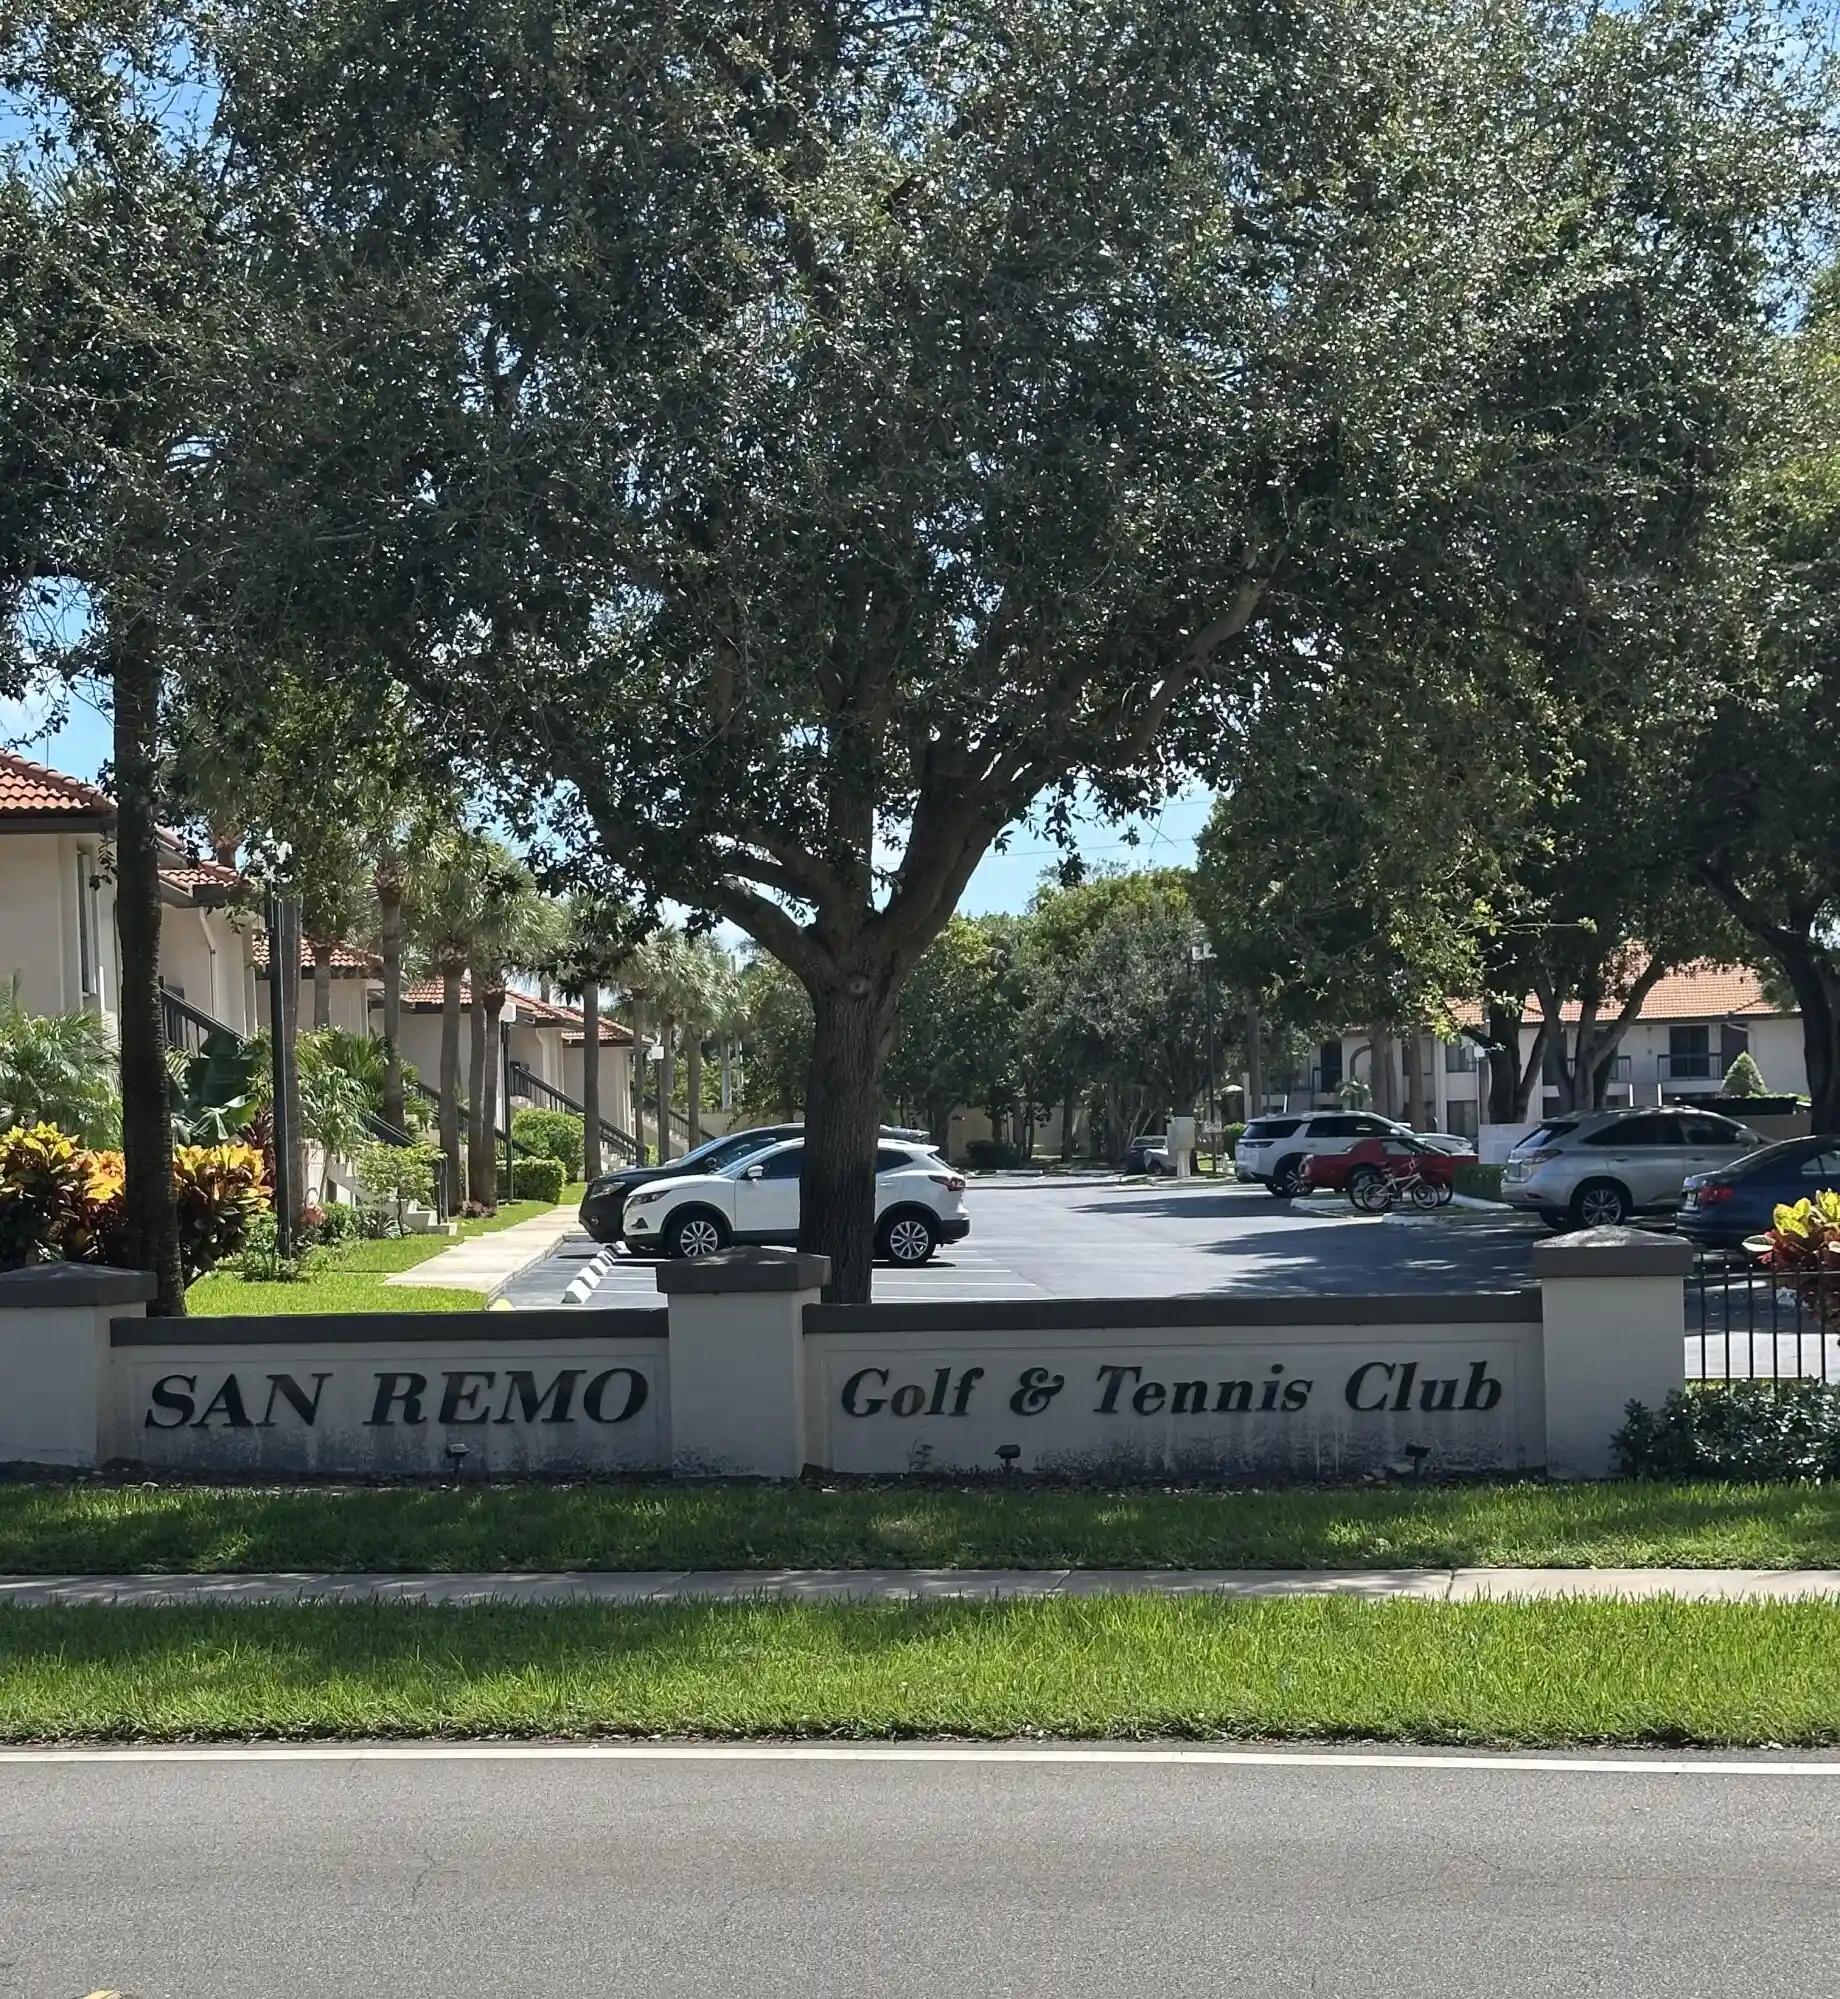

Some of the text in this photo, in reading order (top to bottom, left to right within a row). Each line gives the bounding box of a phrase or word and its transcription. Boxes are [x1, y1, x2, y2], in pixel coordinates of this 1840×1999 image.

[145, 1367, 649, 1429] SAN REMO
[841, 1360, 1502, 1418] Golf & Tennis Club
